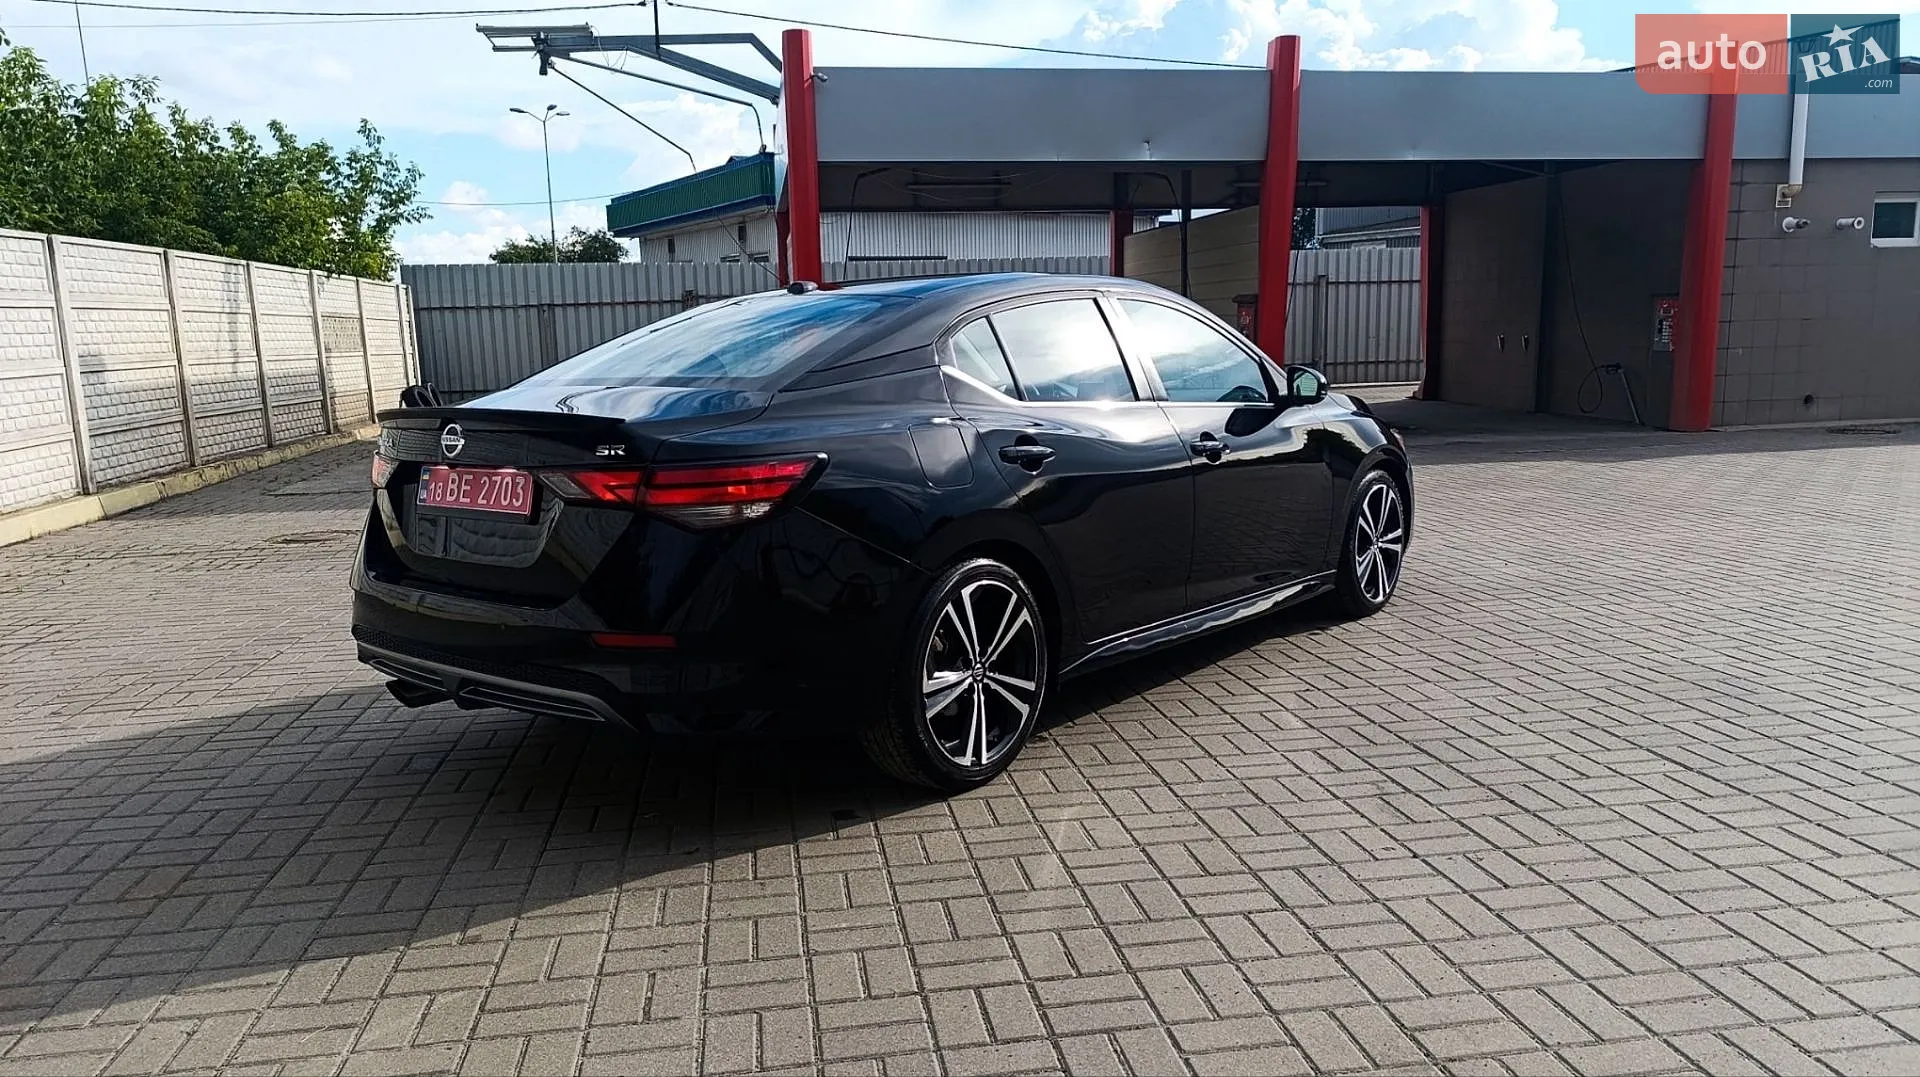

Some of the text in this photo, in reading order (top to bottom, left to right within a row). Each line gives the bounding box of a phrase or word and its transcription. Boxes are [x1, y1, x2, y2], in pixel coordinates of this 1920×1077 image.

[595, 444, 626, 456] SR
[429, 472, 525, 507] 18 BE 2703
